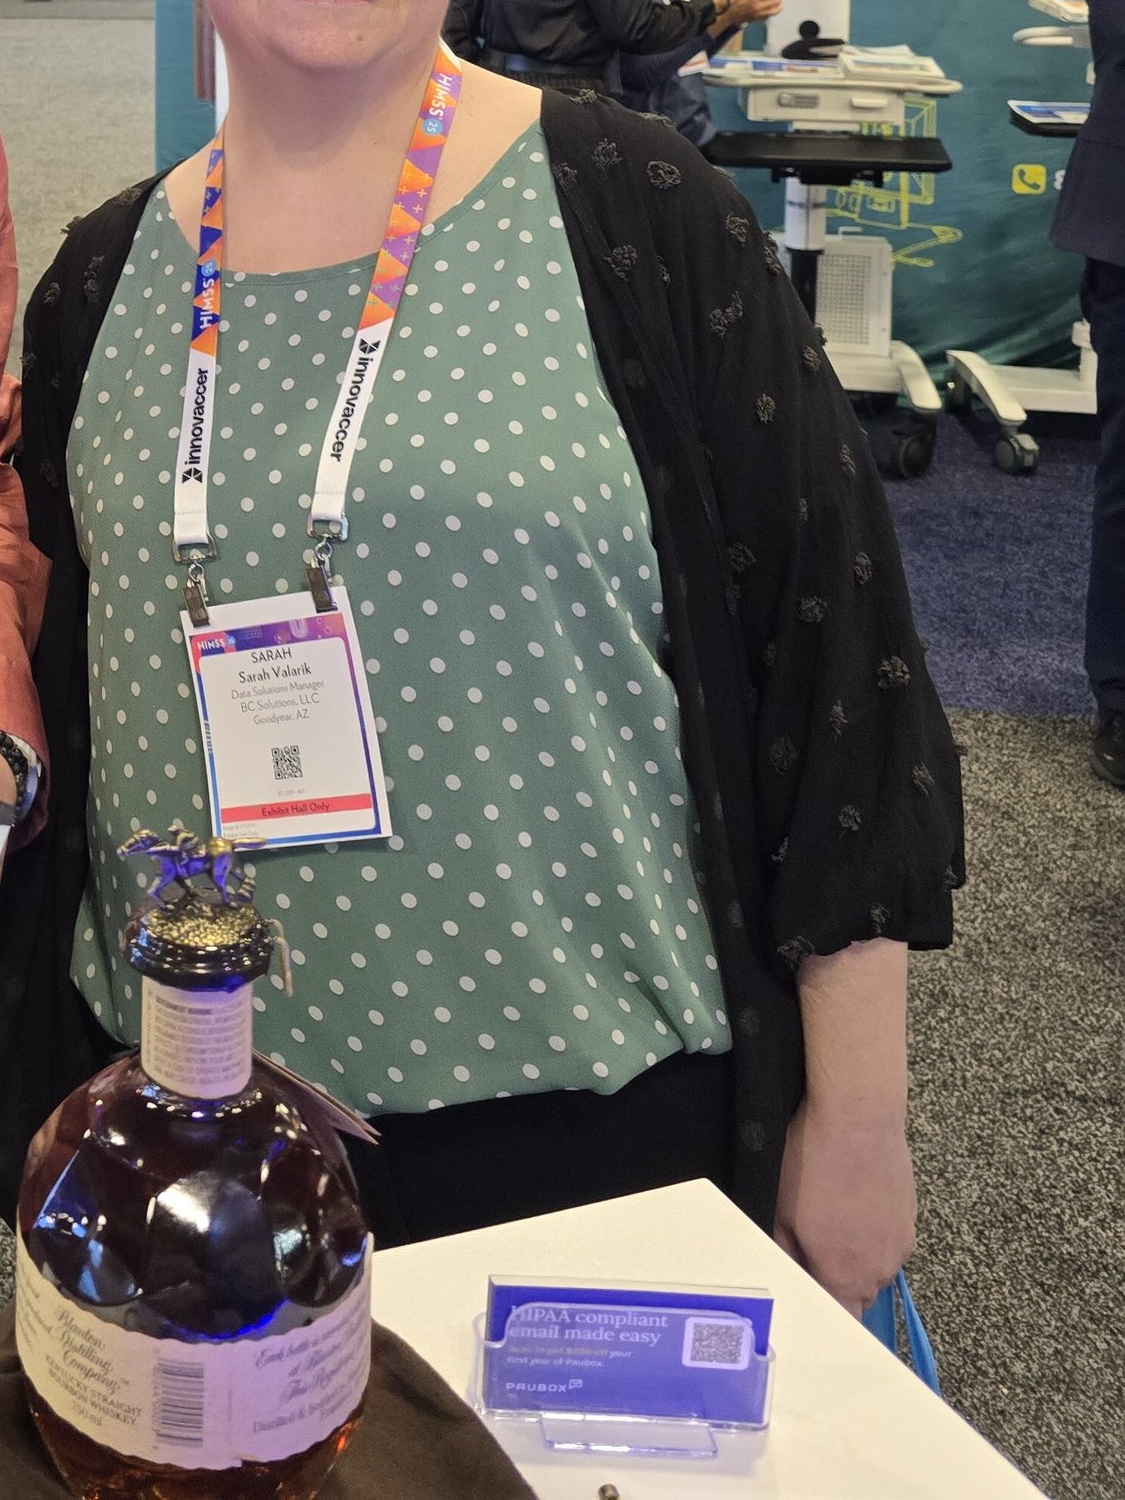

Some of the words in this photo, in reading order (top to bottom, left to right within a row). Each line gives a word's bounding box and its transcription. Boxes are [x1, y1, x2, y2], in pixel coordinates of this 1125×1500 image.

[184, 367, 209, 465] innovaccer
[331, 355, 375, 463] innovaccer
[251, 647, 292, 664] SARAH
[238, 667, 270, 684] Sarah
[271, 662, 312, 678] Valarik
[231, 688, 252, 700] Data
[252, 684, 289, 697] Solutions
[289, 680, 325, 692] Manager
[240, 701, 255, 713] BC
[298, 692, 321, 705] LLC
[296, 708, 310, 720] AZ
[291, 803, 308, 814] Hall
[309, 802, 330, 813] Only
[575, 1311, 669, 1329] compliant
[509, 1324, 560, 1339] email
[564, 1326, 616, 1341] made
[619, 1331, 662, 1347] easy
[506, 1382, 567, 1393] PAUBOX
[90, 1388, 142, 1417] STRAIGHT
[90, 1398, 138, 1425] WHISKEY
